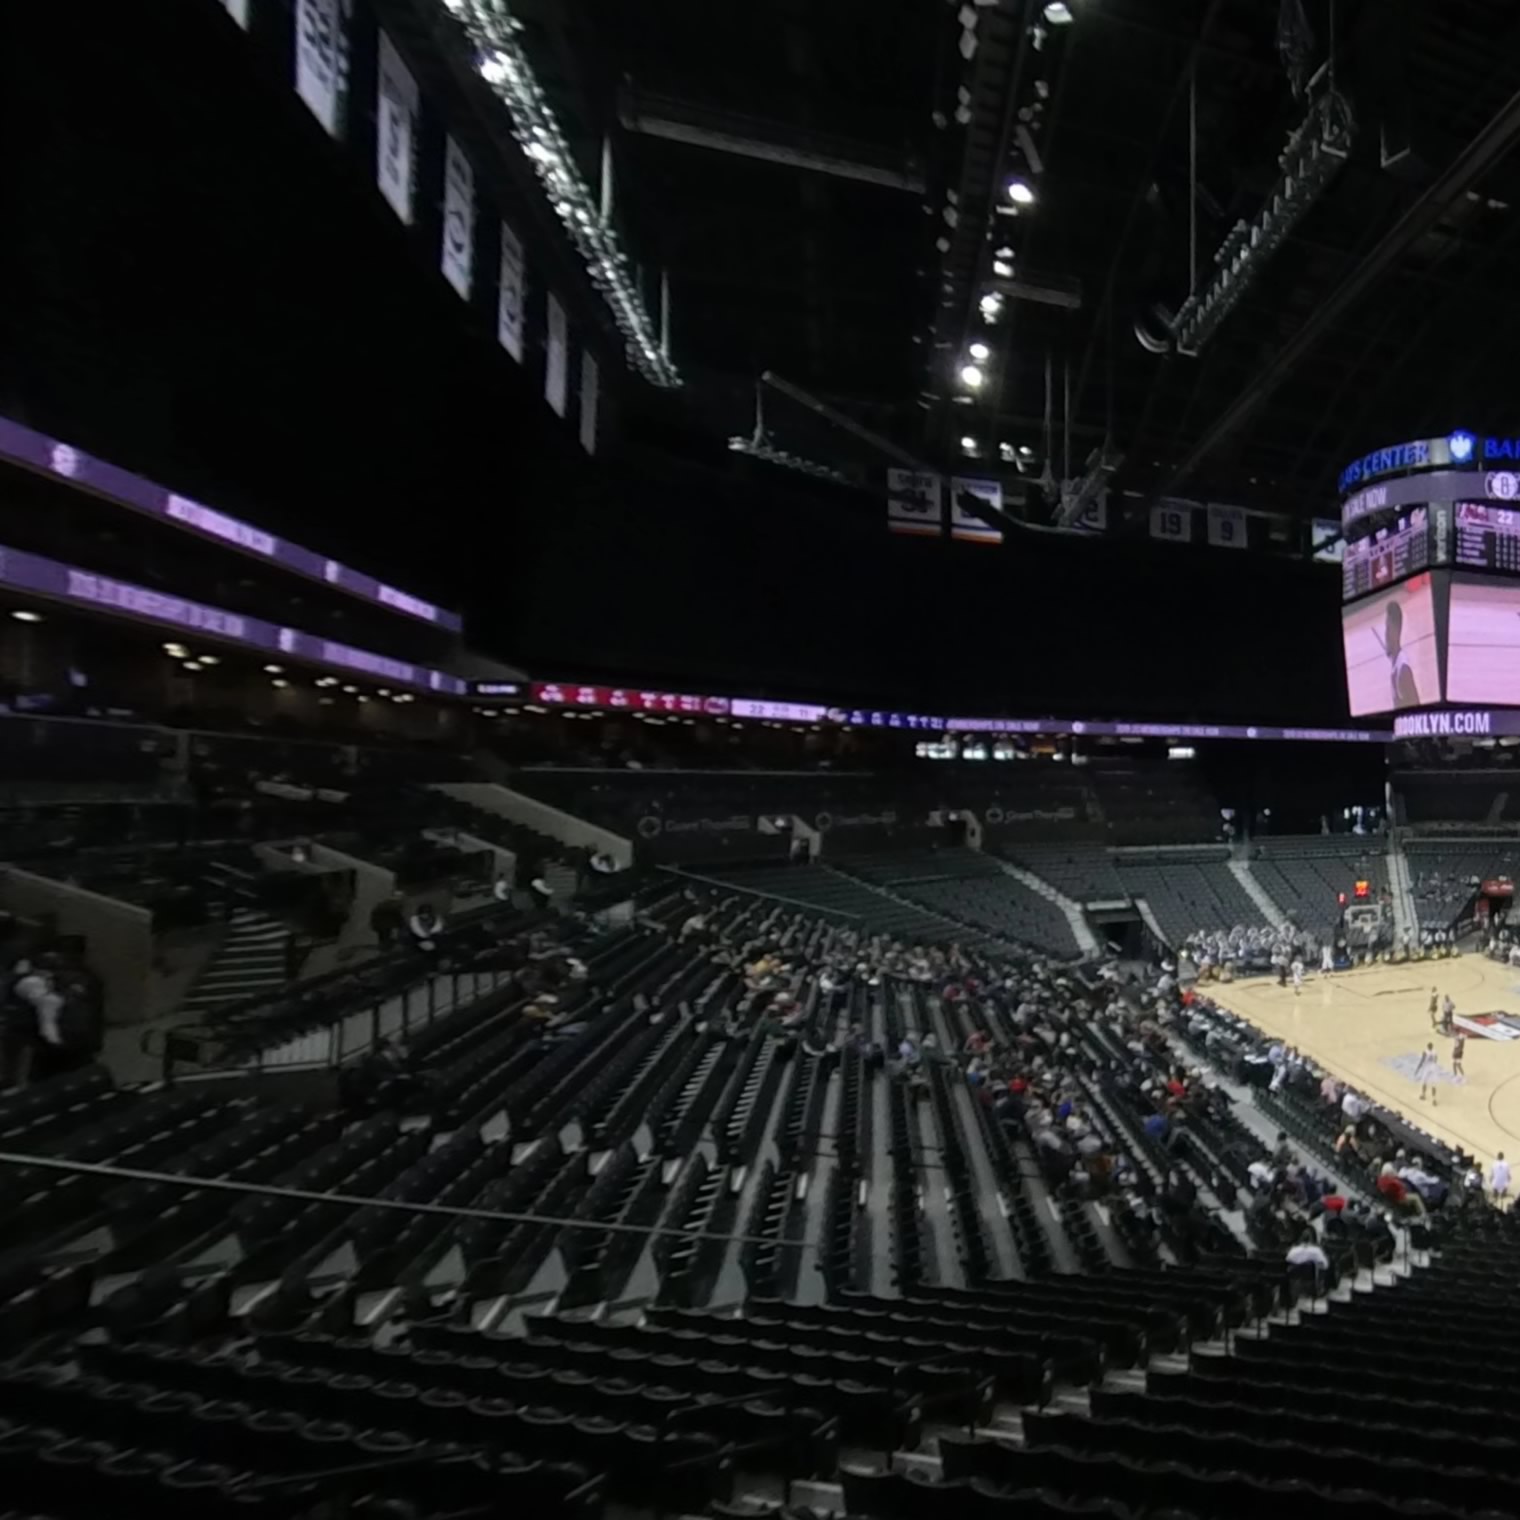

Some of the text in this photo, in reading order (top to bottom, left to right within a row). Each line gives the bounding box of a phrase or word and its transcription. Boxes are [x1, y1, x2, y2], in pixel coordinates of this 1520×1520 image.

[1362, 442, 1428, 476] CENTER
[1160, 511, 1182, 535] 19
[1497, 510, 1513, 525] 22
